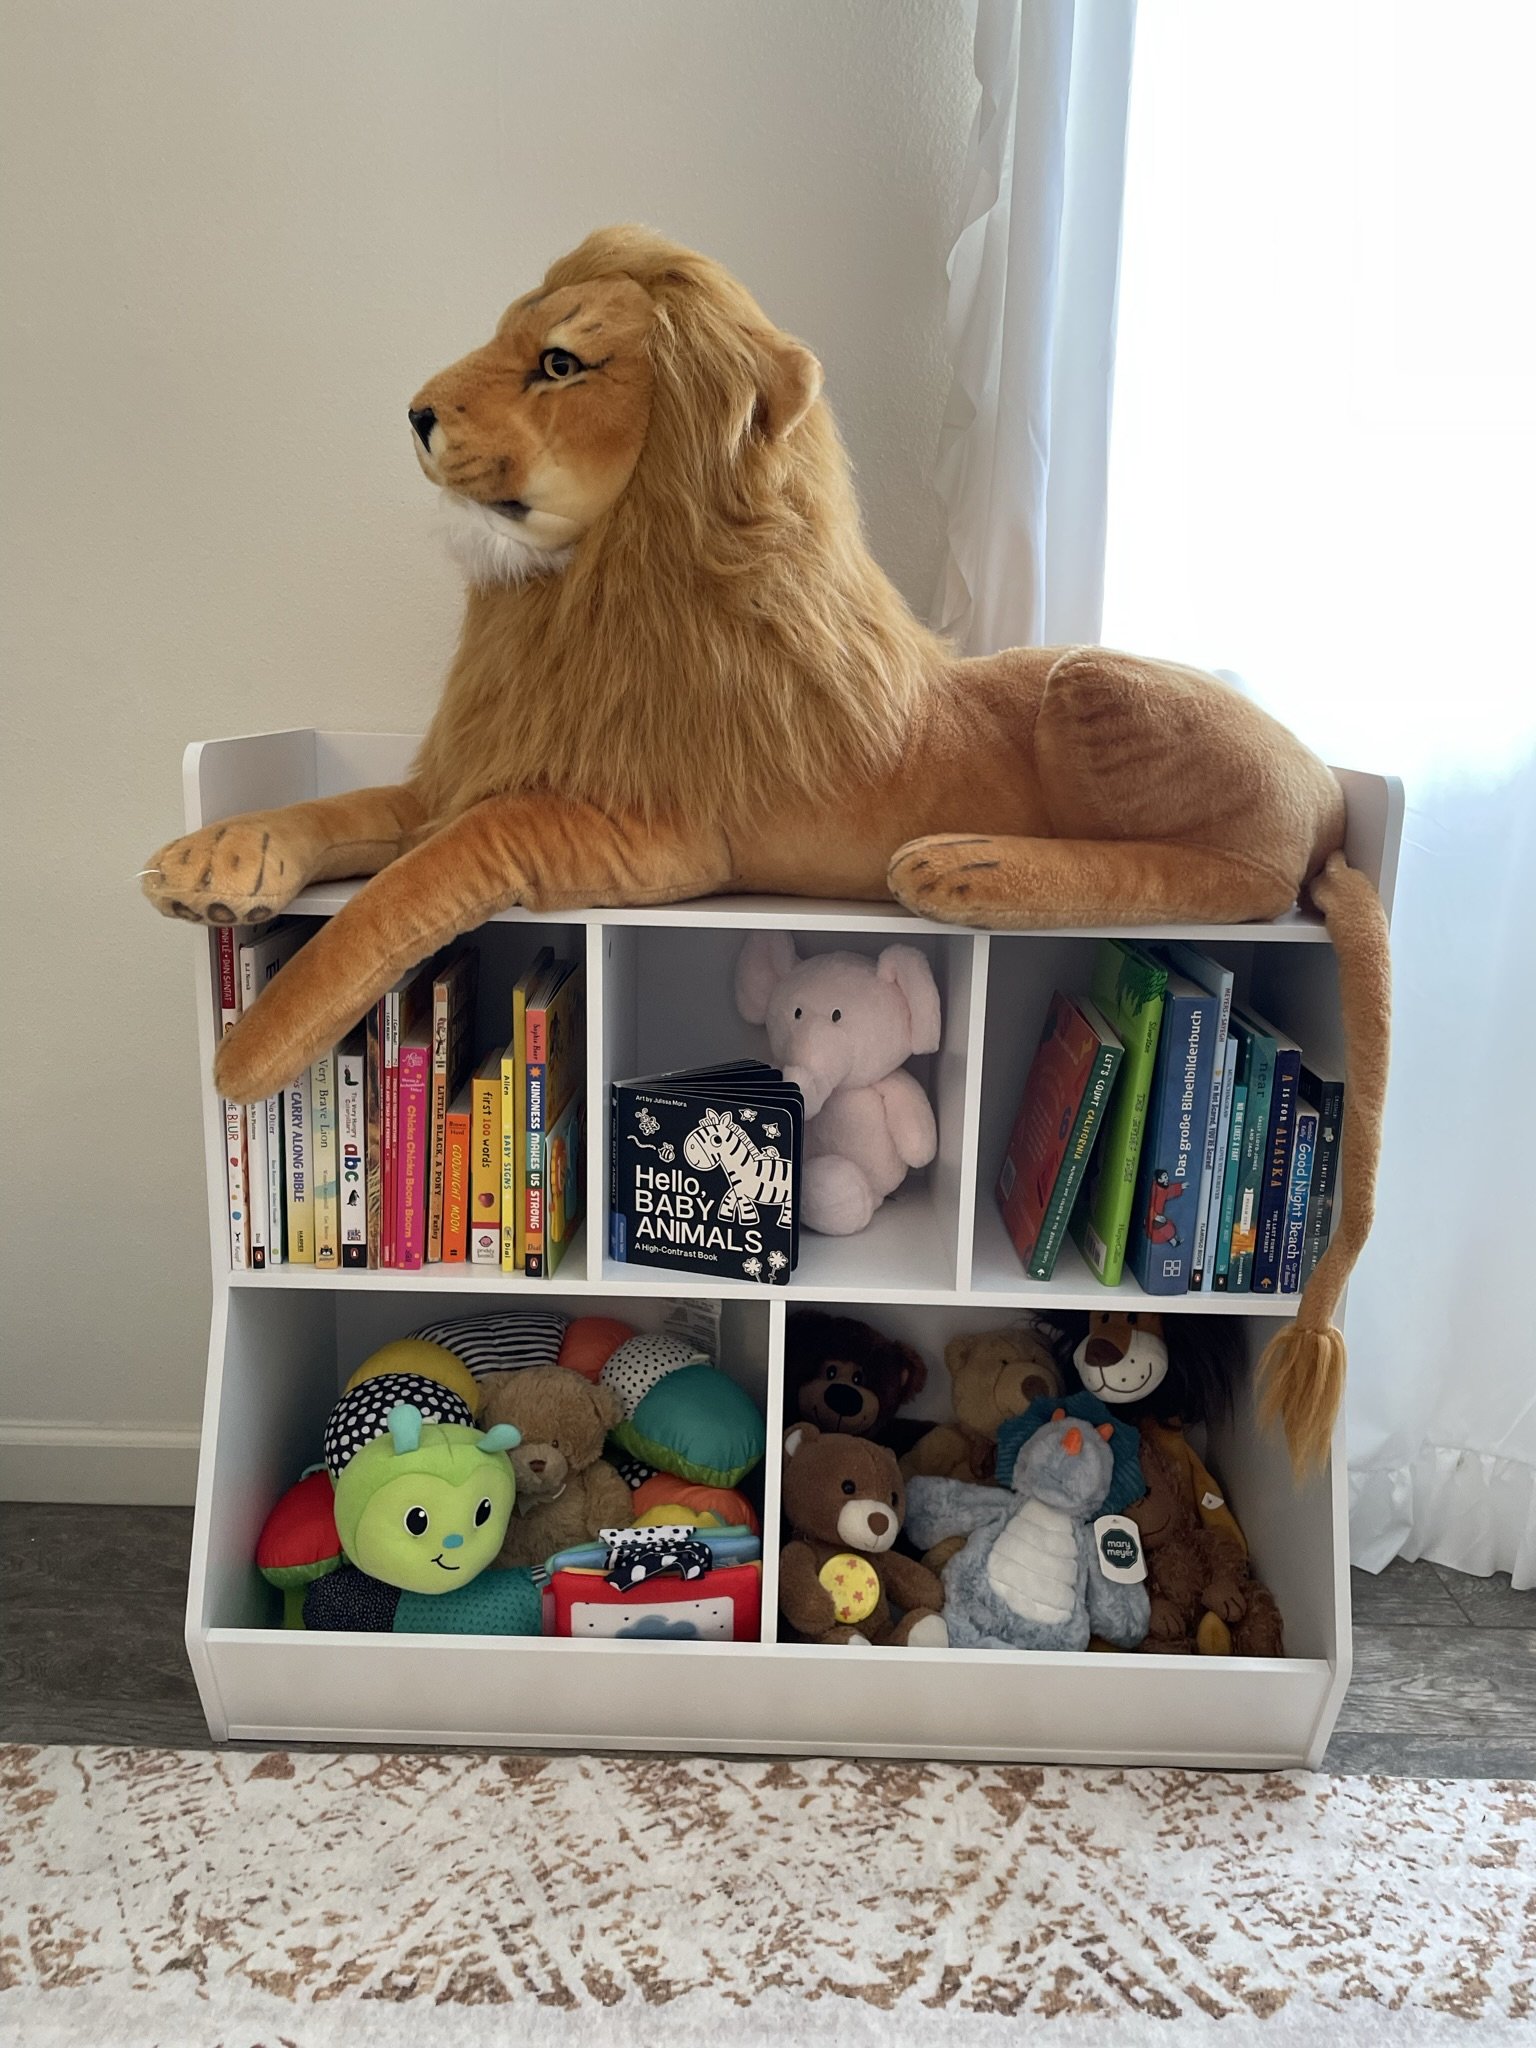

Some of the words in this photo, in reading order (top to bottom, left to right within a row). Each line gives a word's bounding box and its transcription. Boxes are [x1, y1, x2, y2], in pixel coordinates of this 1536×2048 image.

[223, 960, 231, 973] DAN
[223, 976, 232, 1001] SANTAT
[1222, 988, 1231, 1015] MEYERS
[531, 1024, 540, 1044] Sophie
[1219, 1019, 1228, 1043] SAYEGH
[316, 1059, 328, 1084] Very
[1100, 1053, 1114, 1076] LET'S
[1182, 1010, 1202, 1110] Bibelbilderbuch
[1257, 1063, 1268, 1098] near
[1282, 1074, 1293, 1082] A
[269, 1101, 276, 1112] No
[319, 1090, 328, 1118] Brave
[483, 1092, 493, 1115] first
[531, 1081, 540, 1130] KINDNESS
[1091, 1080, 1105, 1107] COUNT
[1282, 1088, 1290, 1098] IS
[291, 1092, 303, 1129] CARRY
[407, 1105, 417, 1140] Chicka
[1280, 1104, 1288, 1121] FOR
[226, 1114, 238, 1140] BLUR
[320, 1124, 330, 1148] Lion
[483, 1119, 491, 1136] 100
[1074, 1109, 1095, 1160] CALIFORNIA
[1179, 1113, 1192, 1151] große
[1233, 1125, 1242, 1141] LIKES
[292, 1131, 304, 1169] ALONG
[344, 1144, 361, 1182] abc
[406, 1142, 416, 1176] Chicka
[482, 1139, 492, 1168] words
[530, 1133, 540, 1170] MAKES
[1231, 1148, 1240, 1161] FART
[1271, 1128, 1288, 1188] ALASKA
[1297, 1144, 1311, 1177] Good
[452, 1144, 462, 1201] GOODNIGHT
[530, 1173, 540, 1186] US
[1175, 1153, 1188, 1177] Das
[293, 1172, 304, 1202] BIBLE
[405, 1178, 414, 1207] Boom
[635, 1164, 707, 1198] Hello,
[530, 1191, 540, 1229] STRONG
[635, 1189, 715, 1221] BABY
[1290, 1180, 1306, 1217] Night
[405, 1209, 414, 1238] Boom
[450, 1204, 459, 1233] MOON
[635, 1216, 763, 1254] ANIMALS
[1287, 1222, 1302, 1260] Beach
[635, 1242, 640, 1250] A
[642, 1244, 696, 1258] High-Contrast
[698, 1251, 718, 1261] Book
[1107, 1549, 1133, 1558] meyer
[1108, 1541, 1130, 1550] mary
